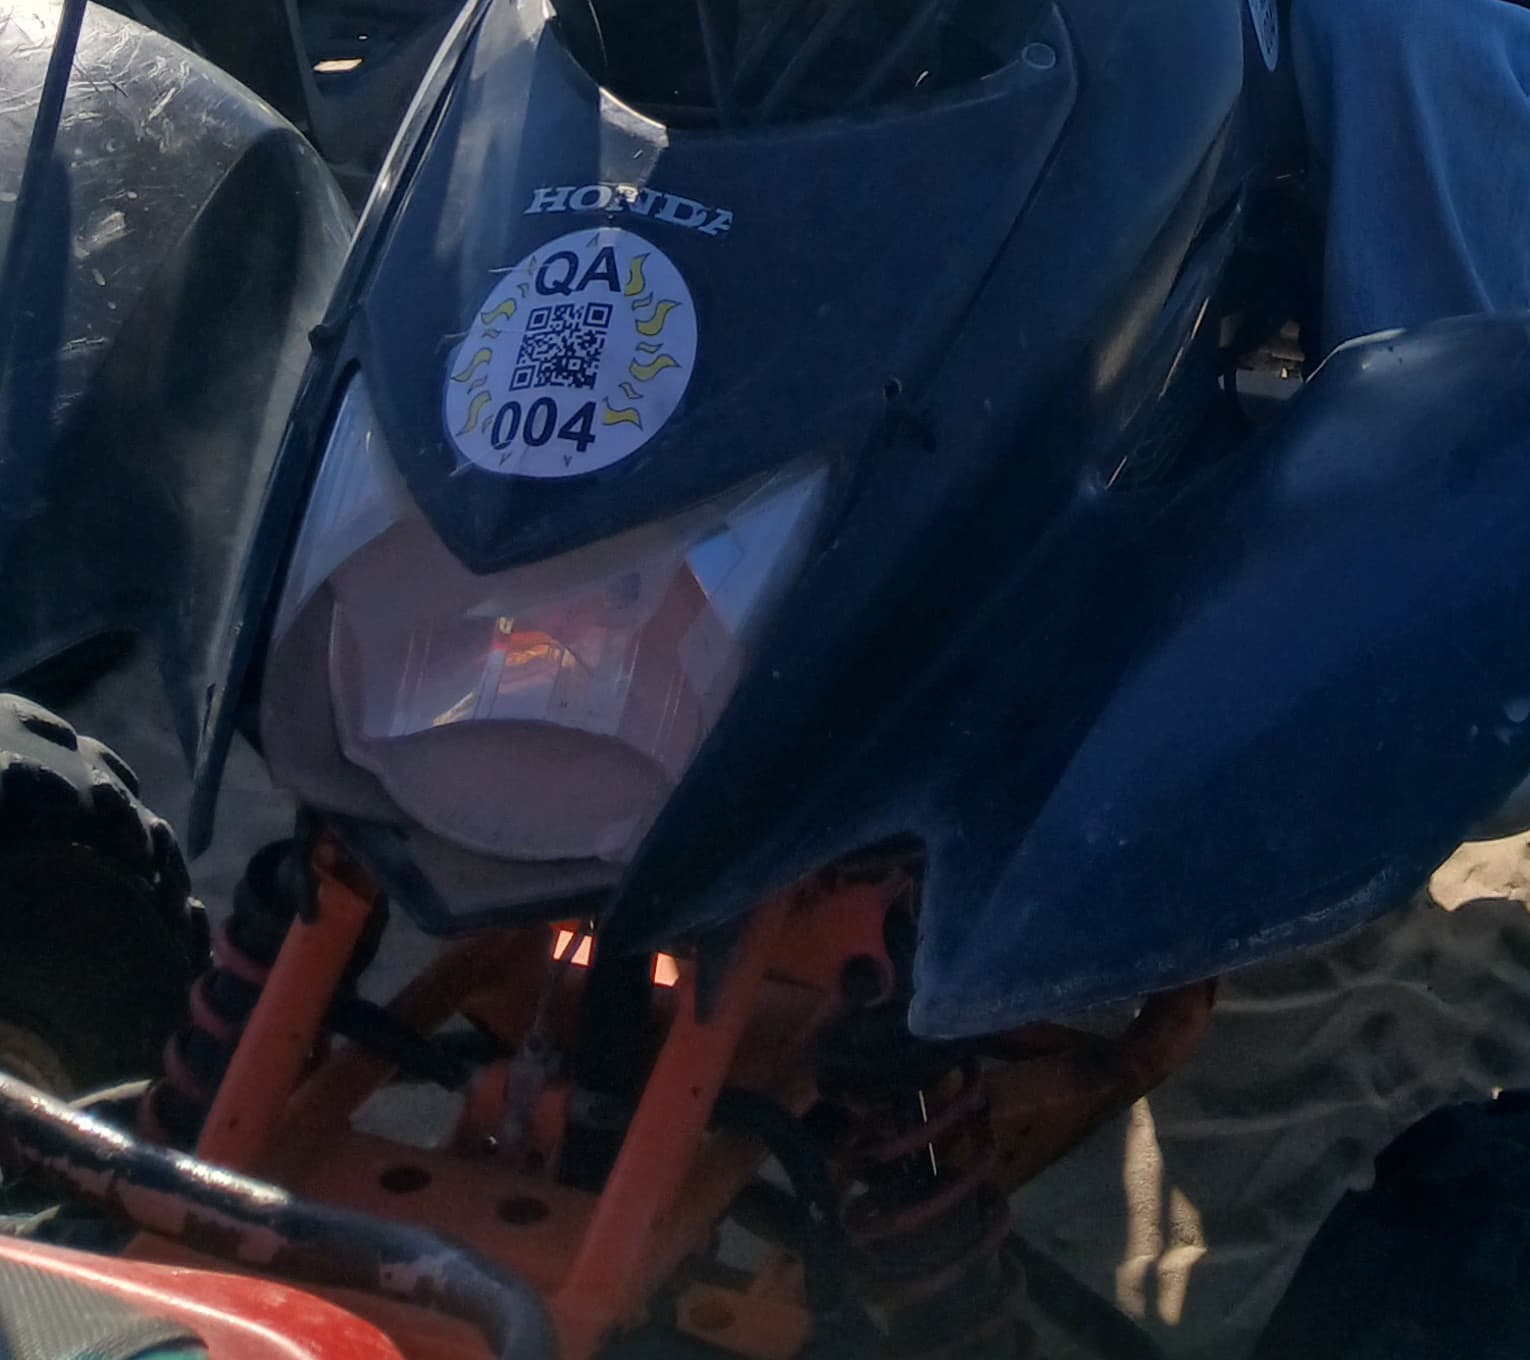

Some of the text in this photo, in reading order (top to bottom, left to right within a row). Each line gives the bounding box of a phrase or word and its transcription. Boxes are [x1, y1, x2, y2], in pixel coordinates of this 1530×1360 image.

[524, 184, 735, 236] HONDA
[535, 246, 622, 296] QA
[490, 397, 597, 453] 004
